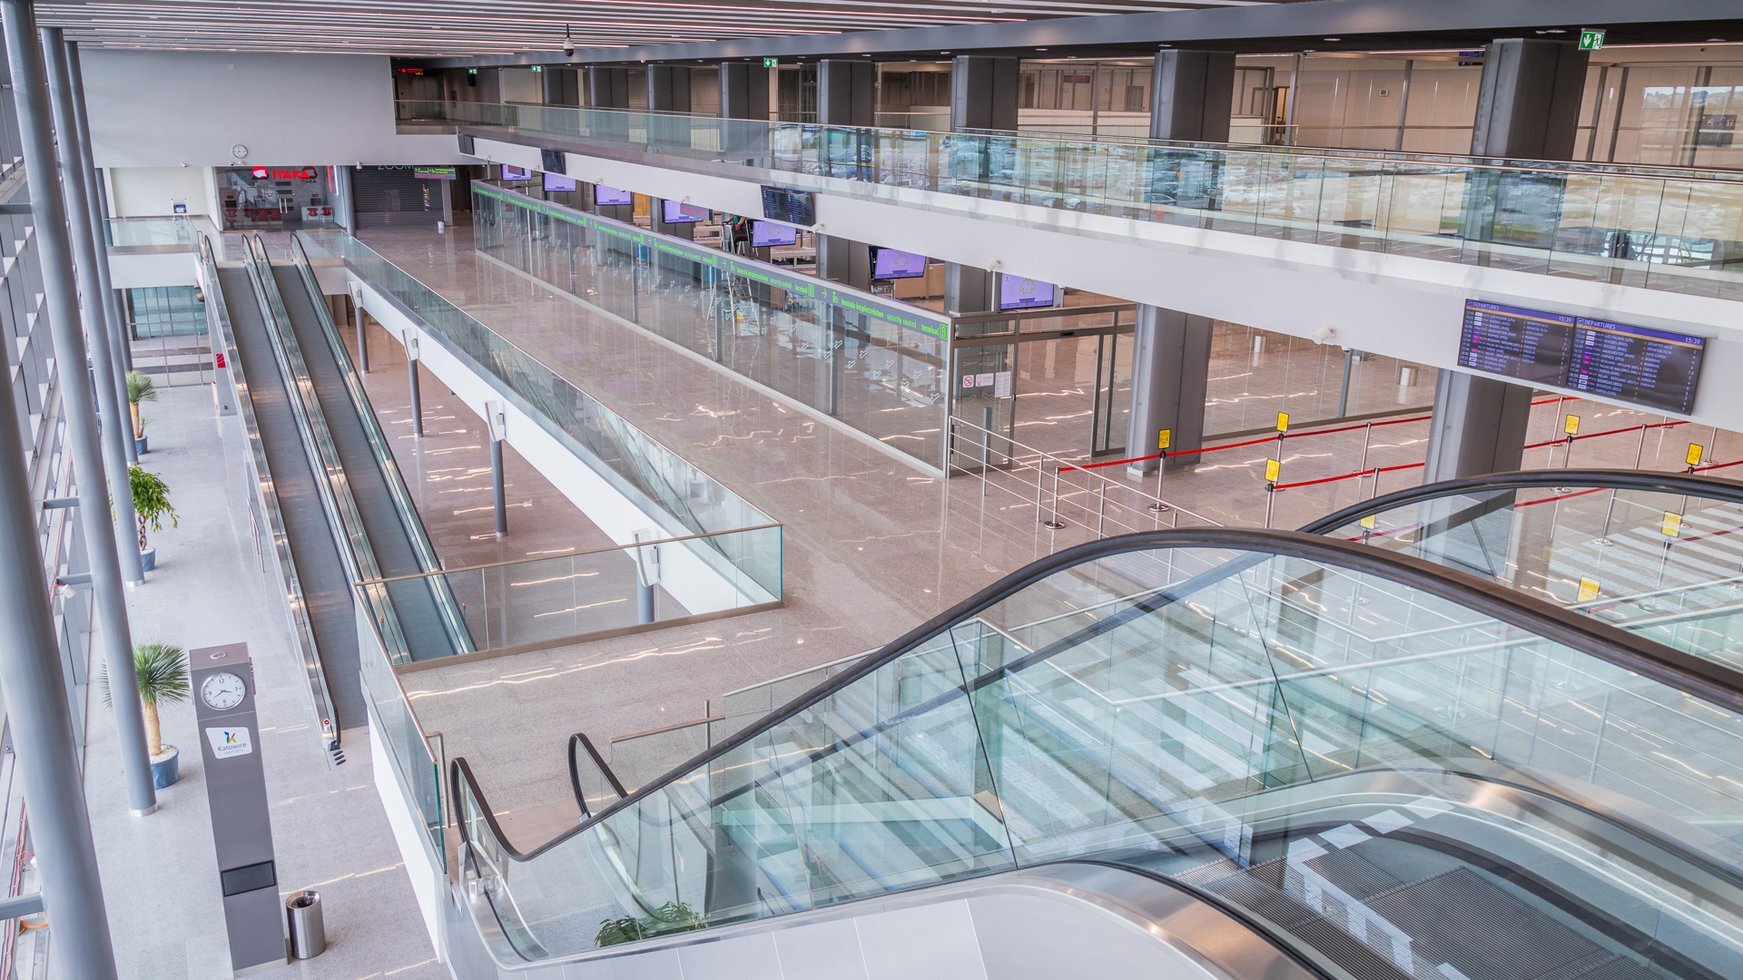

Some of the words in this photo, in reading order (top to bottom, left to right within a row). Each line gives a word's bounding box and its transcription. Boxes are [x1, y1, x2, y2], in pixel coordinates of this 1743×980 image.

[272, 169, 310, 179] ITAKA
[1473, 302, 1500, 310] DEPARTURES
[1584, 319, 1616, 329] DEPARTURES
[217, 742, 247, 751] Katowice
